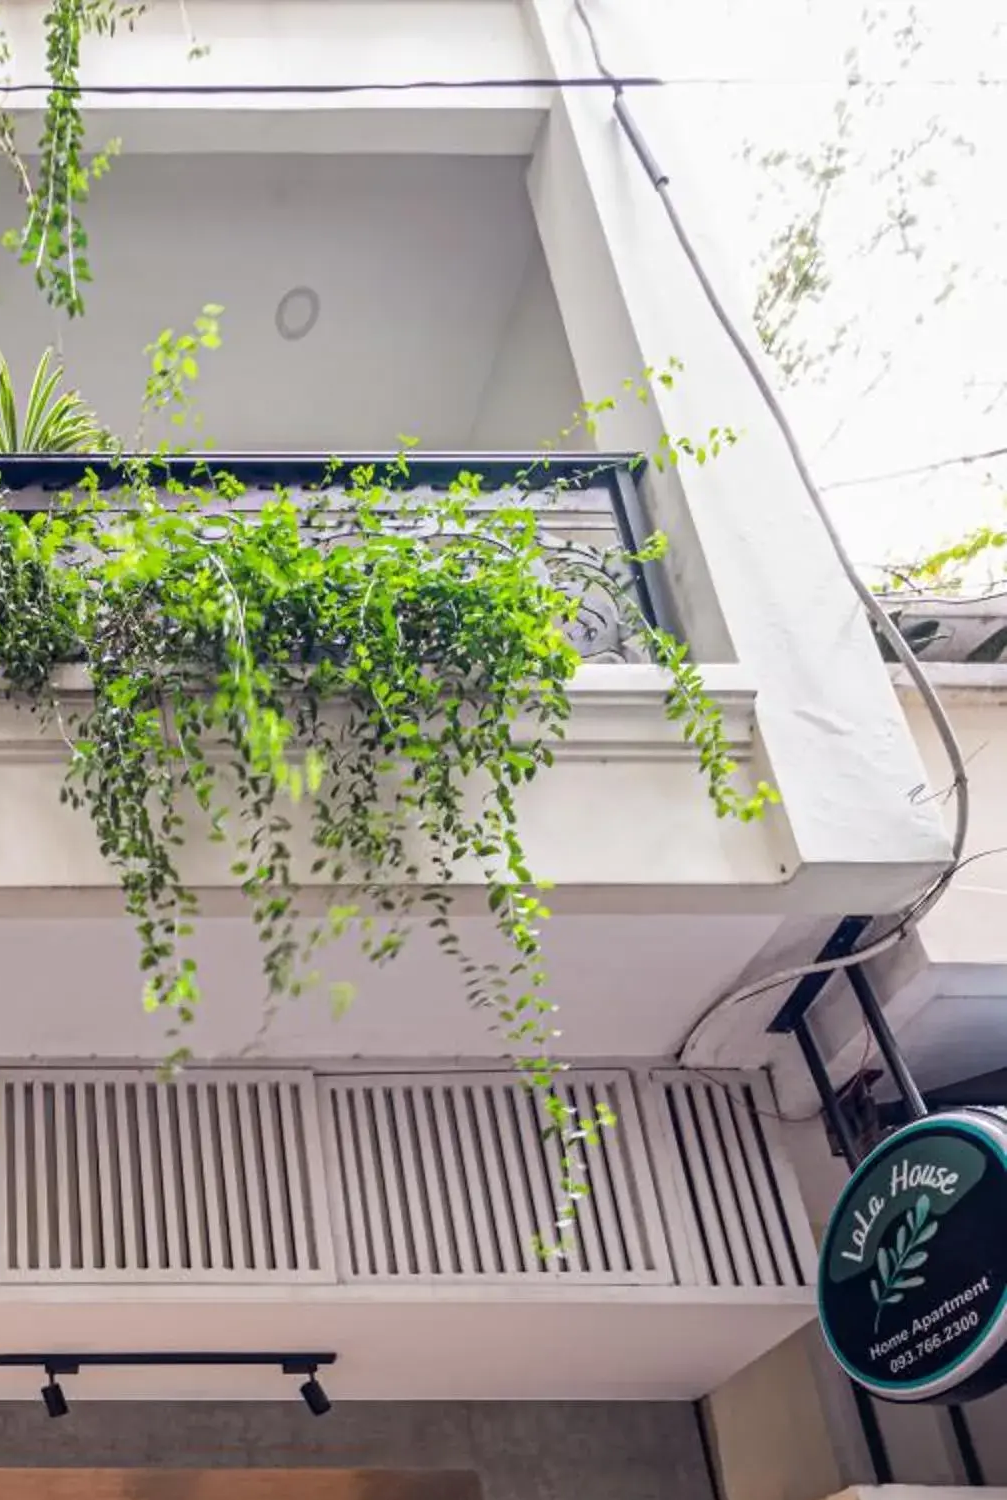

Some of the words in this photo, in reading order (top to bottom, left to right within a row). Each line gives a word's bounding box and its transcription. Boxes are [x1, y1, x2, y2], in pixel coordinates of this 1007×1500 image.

[890, 1159, 959, 1197] House
[869, 1330, 909, 1361] Home
[912, 1275, 990, 1335] Apartment
